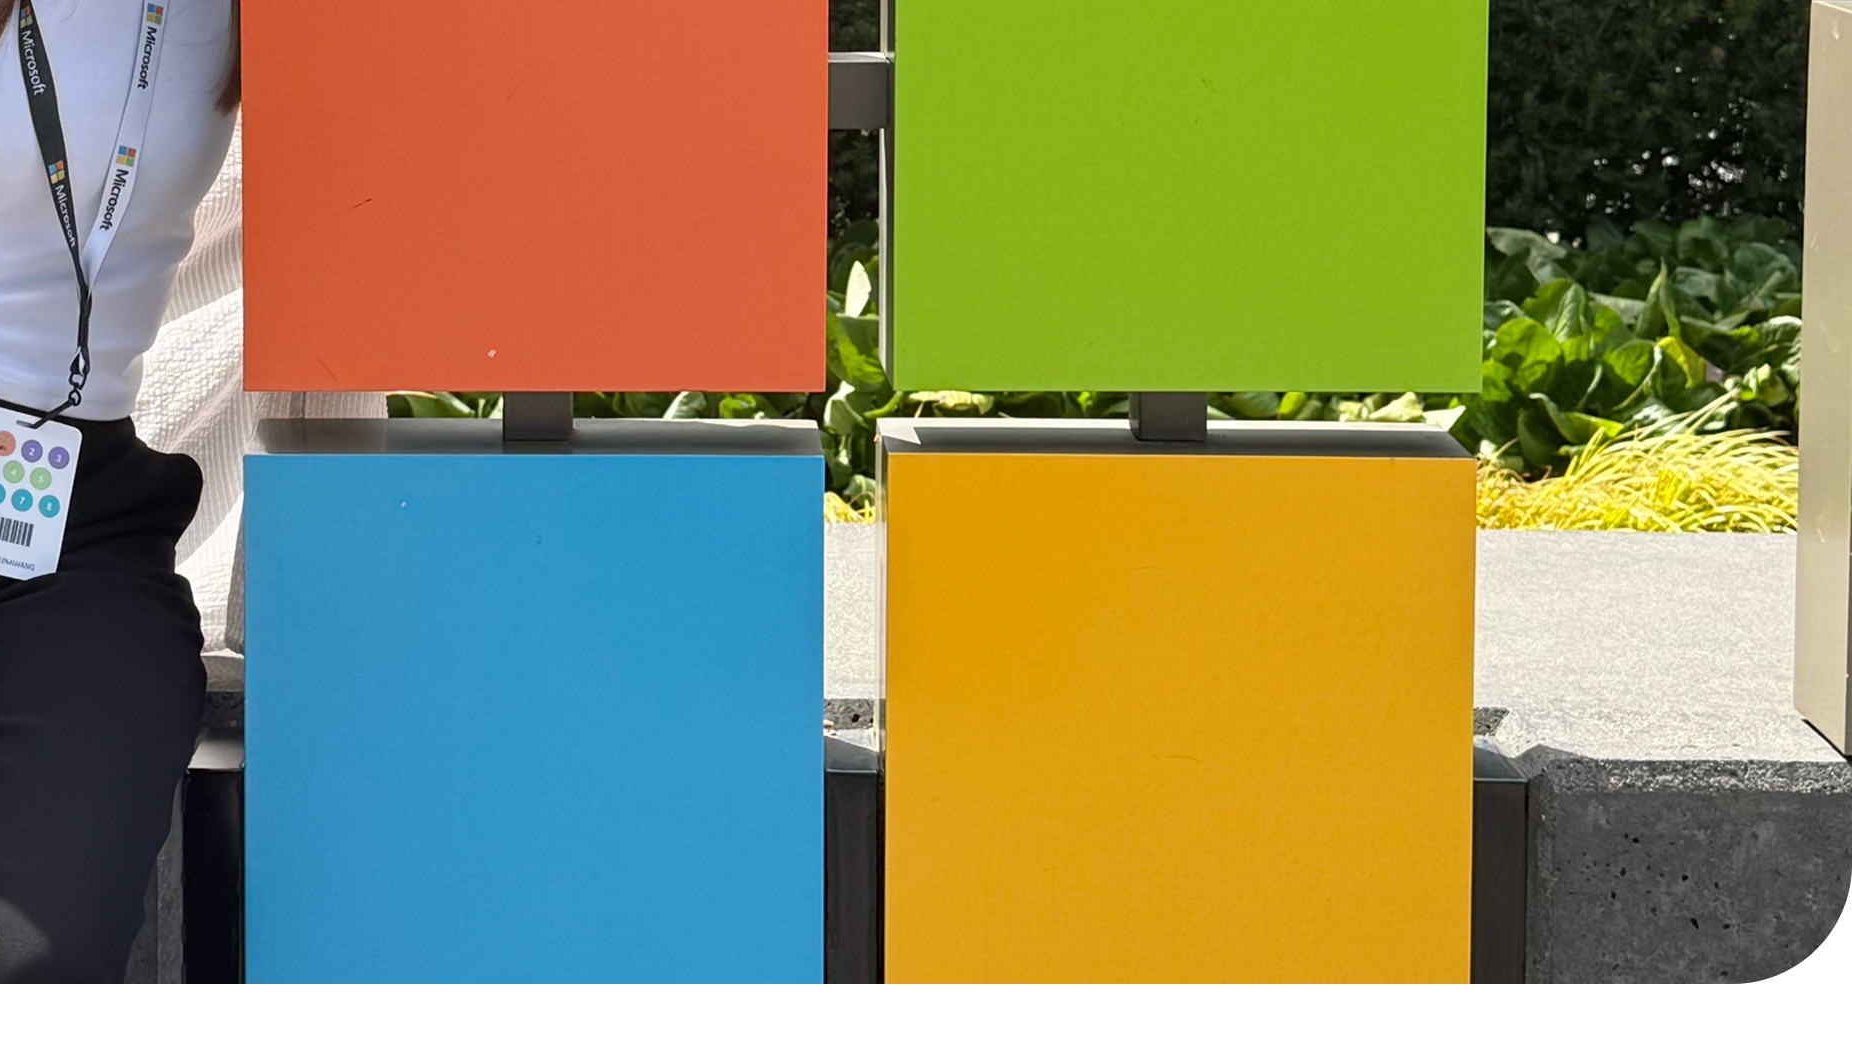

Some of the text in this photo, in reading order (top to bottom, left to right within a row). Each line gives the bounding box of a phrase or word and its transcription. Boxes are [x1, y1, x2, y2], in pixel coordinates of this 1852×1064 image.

[21, 30, 47, 96] Microsoft
[137, 26, 157, 90] Microsoft
[55, 184, 76, 248] Microsoft
[100, 169, 129, 231] Microsoft
